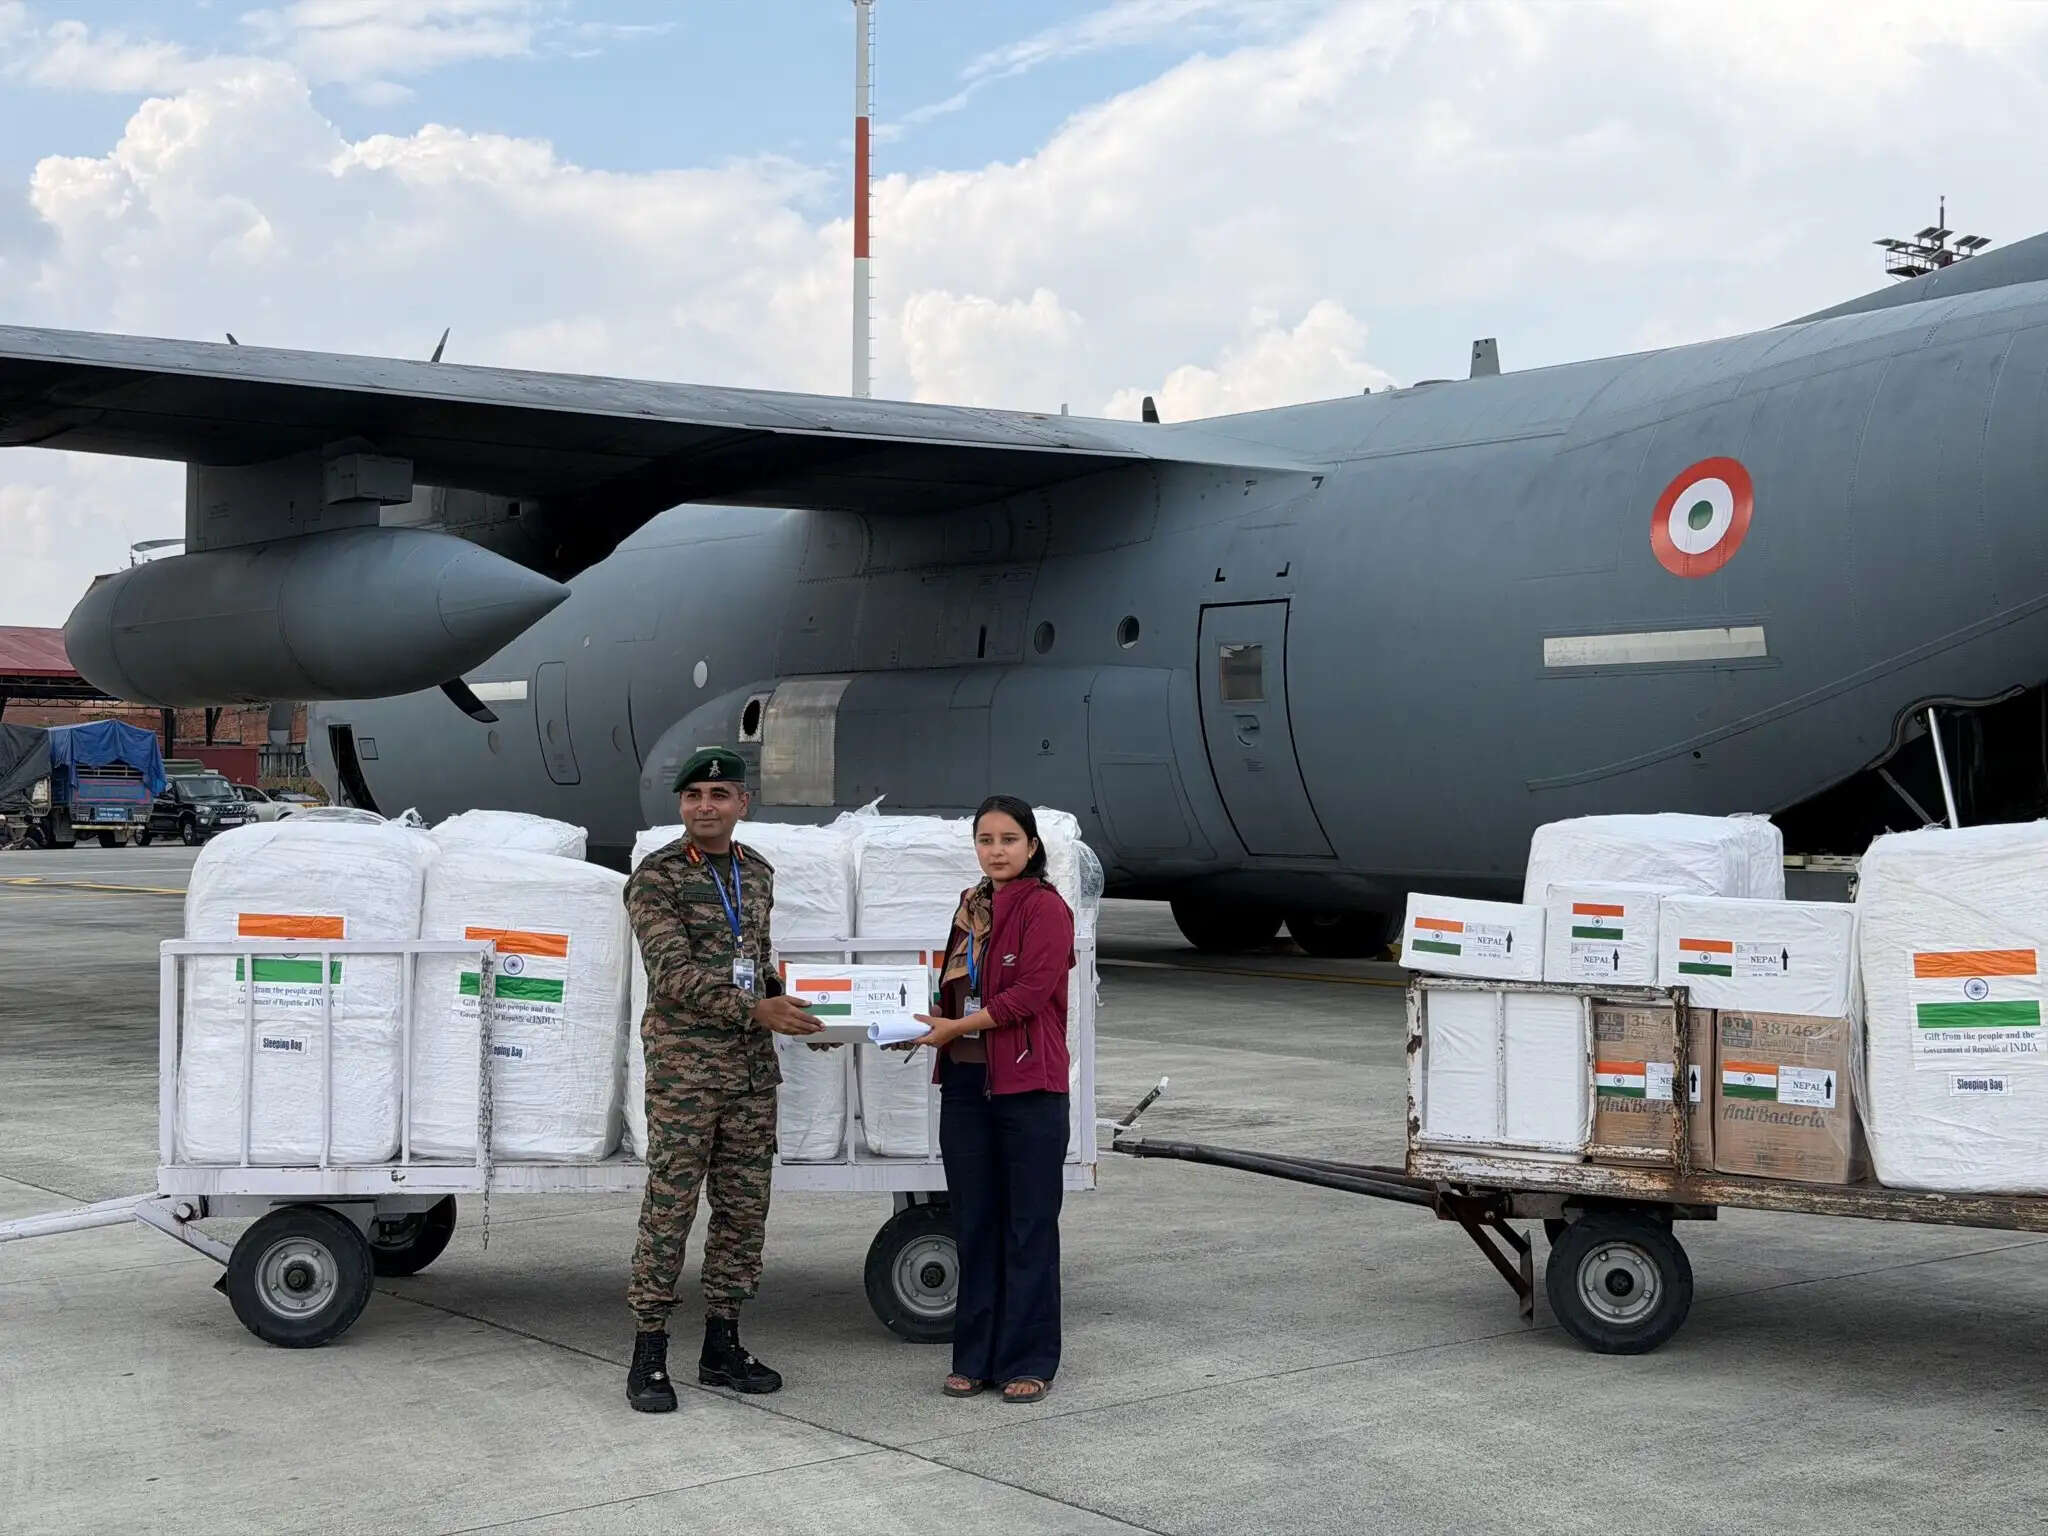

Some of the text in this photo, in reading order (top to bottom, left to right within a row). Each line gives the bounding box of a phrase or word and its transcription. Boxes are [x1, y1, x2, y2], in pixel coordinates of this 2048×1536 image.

[1477, 936, 1504, 946] NEPAL
[1583, 955, 1609, 964] NEPAL
[1750, 955, 1778, 964] NEPAL
[273, 986, 284, 994] the
[285, 986, 308, 997] people
[867, 992, 898, 1001] NEPAL
[311, 998, 336, 1008] INA
[507, 1002, 530, 1012] people
[530, 1004, 544, 1012] and
[545, 1006, 556, 1014] the
[530, 1014, 556, 1025] INDIA
[1924, 1030, 2035, 1042] Gift from the people and the
[263, 1037, 303, 1052] Sleeping Bag
[1923, 1045, 1963, 1054] Government
[1972, 1045, 2001, 1055] Republic
[2001, 1045, 2009, 1053] of
[2009, 1042, 2038, 1053] INDIA
[511, 1046, 523, 1058] Bag
[1792, 1080, 1822, 1091] NEPAL
[1957, 1078, 2003, 1091] Sleeping Bag
